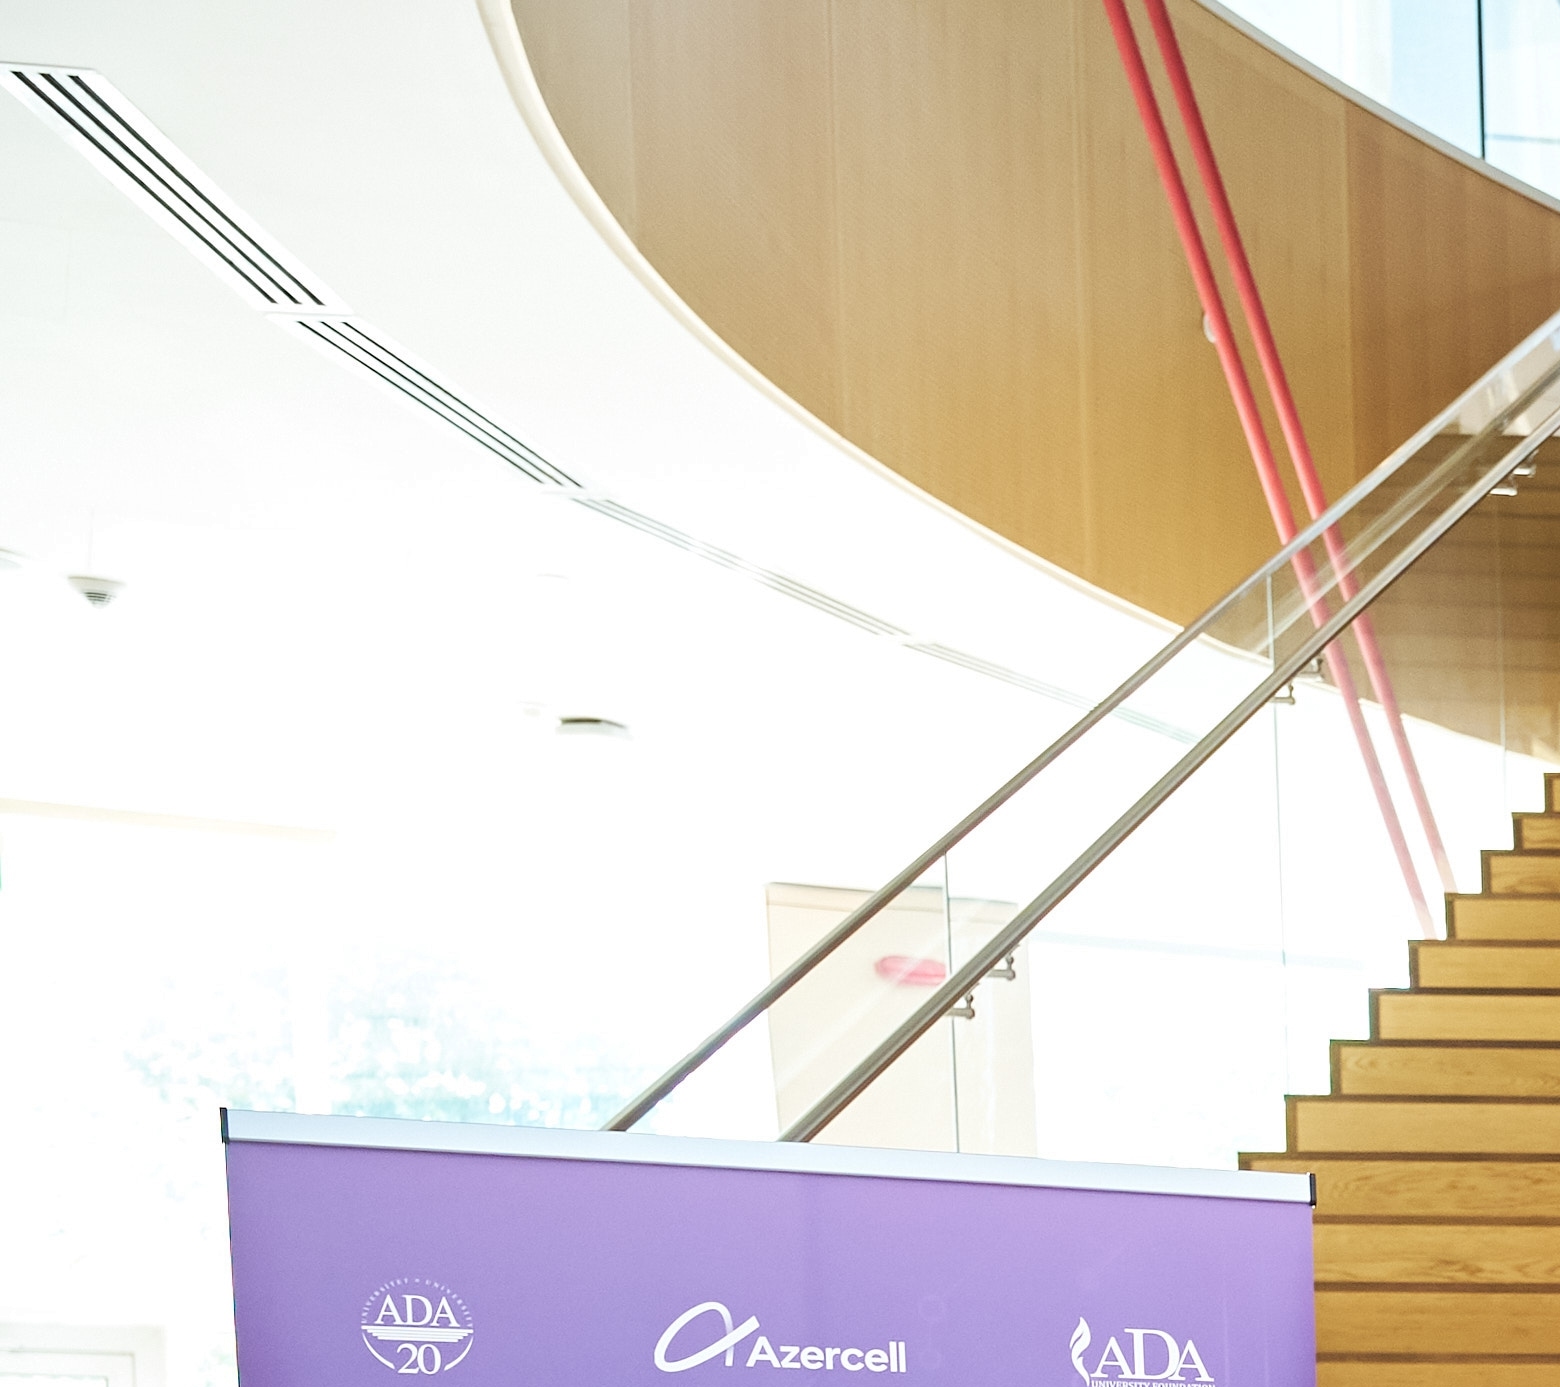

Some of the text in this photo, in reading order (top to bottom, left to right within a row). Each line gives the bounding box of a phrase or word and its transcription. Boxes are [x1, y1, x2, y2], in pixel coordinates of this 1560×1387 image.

[374, 1294, 460, 1327] ADA
[397, 1343, 441, 1374] 20
[746, 1332, 906, 1375] Azercell
[1090, 1328, 1214, 1382] ADA
